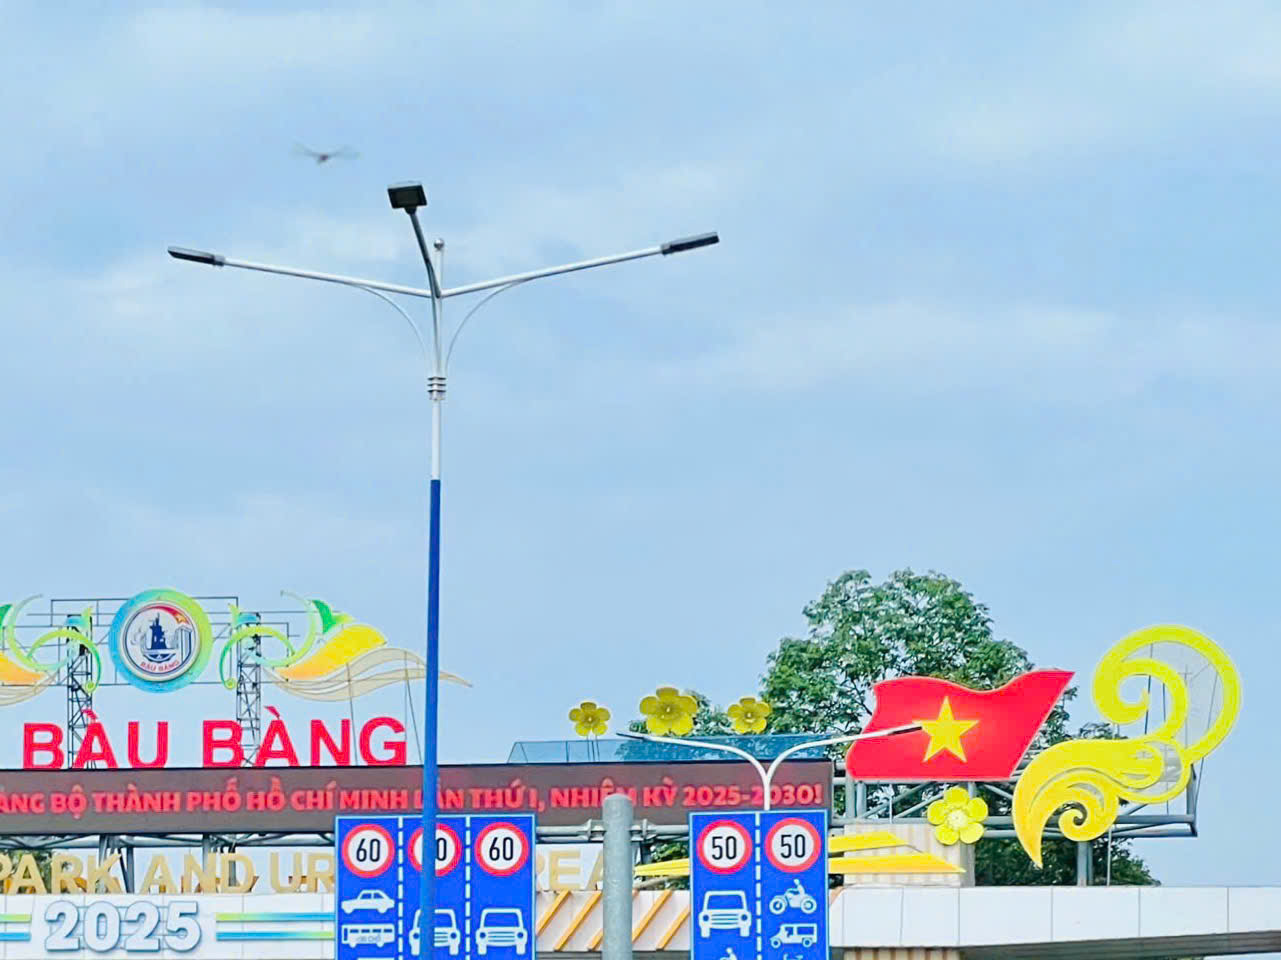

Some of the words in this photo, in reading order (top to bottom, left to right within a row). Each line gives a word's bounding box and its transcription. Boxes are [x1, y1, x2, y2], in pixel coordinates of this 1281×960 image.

[22, 708, 169, 769] BÀU
[202, 705, 408, 768] BÀNG
[50, 784, 87, 820] BỘ
[91, 783, 182, 813] THÀNH
[186, 776, 243, 812] PHỐ
[247, 776, 286, 811] HỒ
[290, 780, 337, 810] CHÍ
[339, 789, 409, 811] MINH
[469, 778, 526, 809] THỨ
[682, 784, 823, 807] 2025-2030!
[356, 838, 381, 862] 60
[488, 836, 514, 862] 60
[711, 835, 738, 861] 50
[780, 834, 806, 859] 50
[141, 852, 256, 895] AND
[43, 900, 202, 953] 2025
